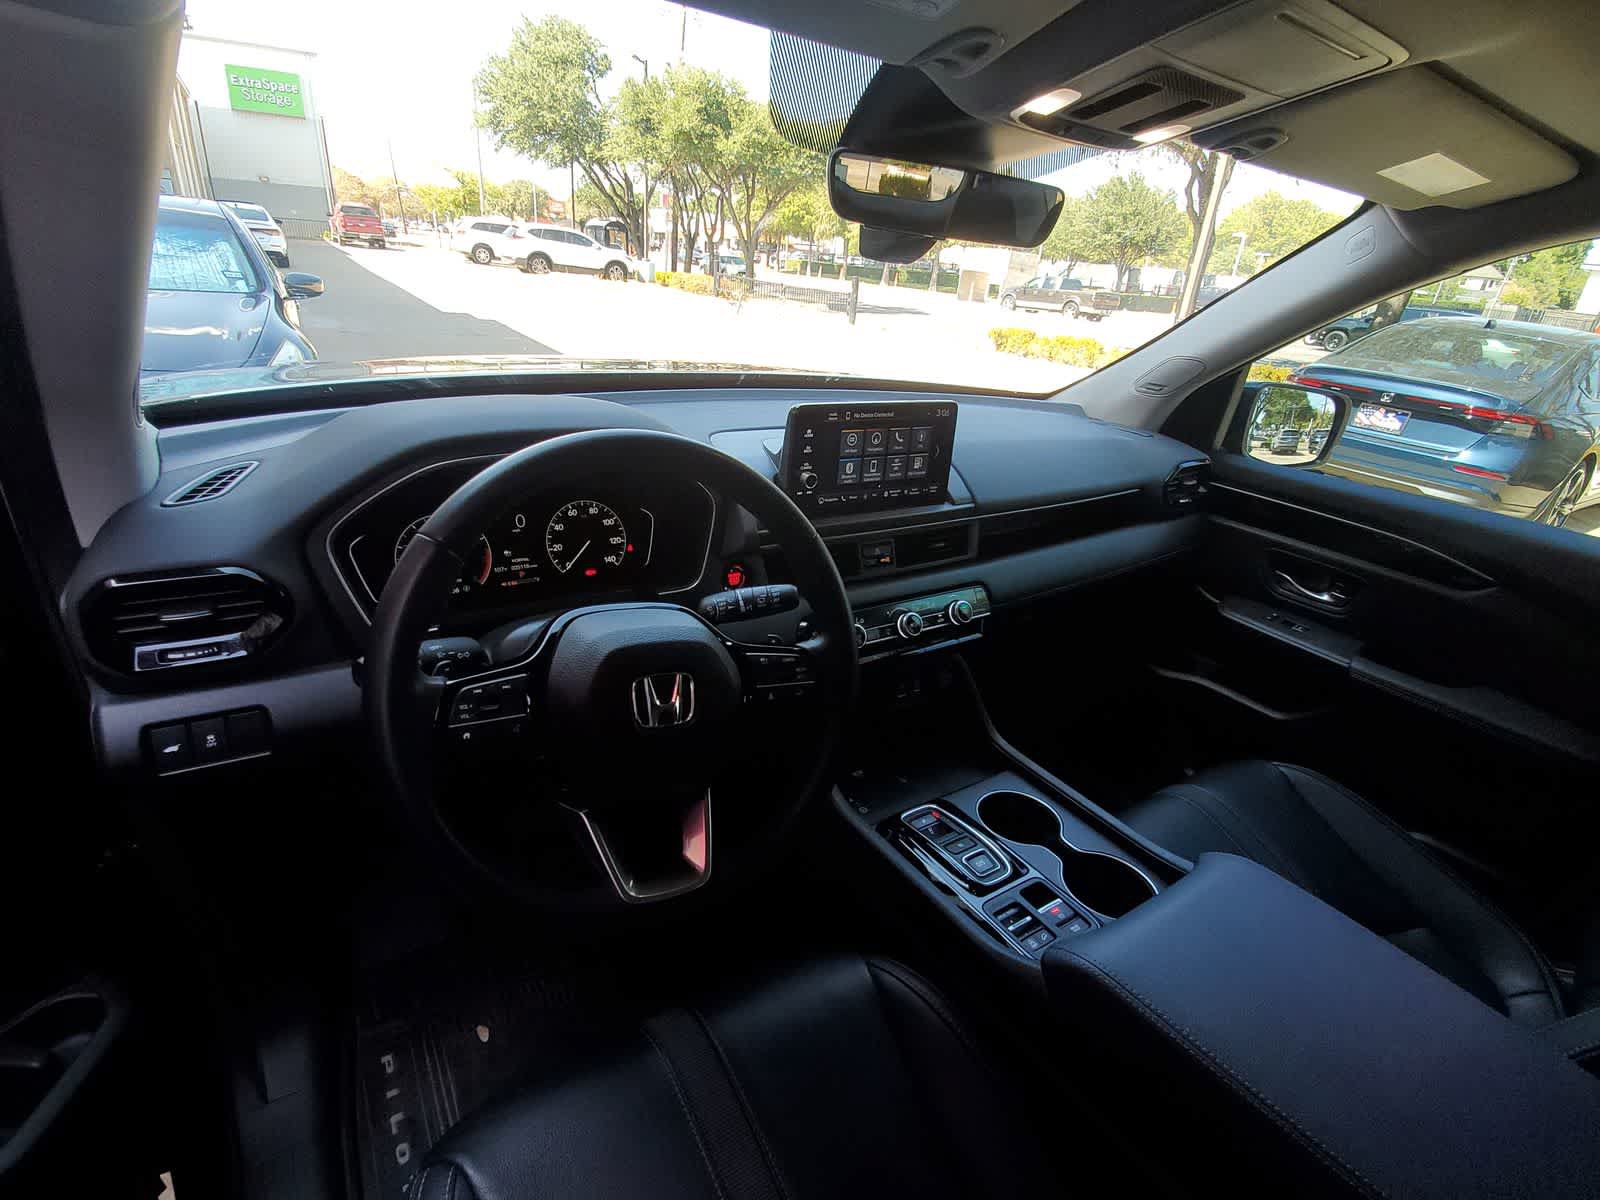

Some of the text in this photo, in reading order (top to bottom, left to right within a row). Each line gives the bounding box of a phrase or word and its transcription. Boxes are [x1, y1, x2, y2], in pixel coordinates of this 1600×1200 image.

[241, 88, 293, 107] Storage
[567, 509, 578, 517] 60
[515, 514, 526, 528] 0
[602, 518, 615, 526] 100
[554, 523, 564, 531] 40
[552, 544, 563, 552] 20
[603, 555, 616, 563] 140
